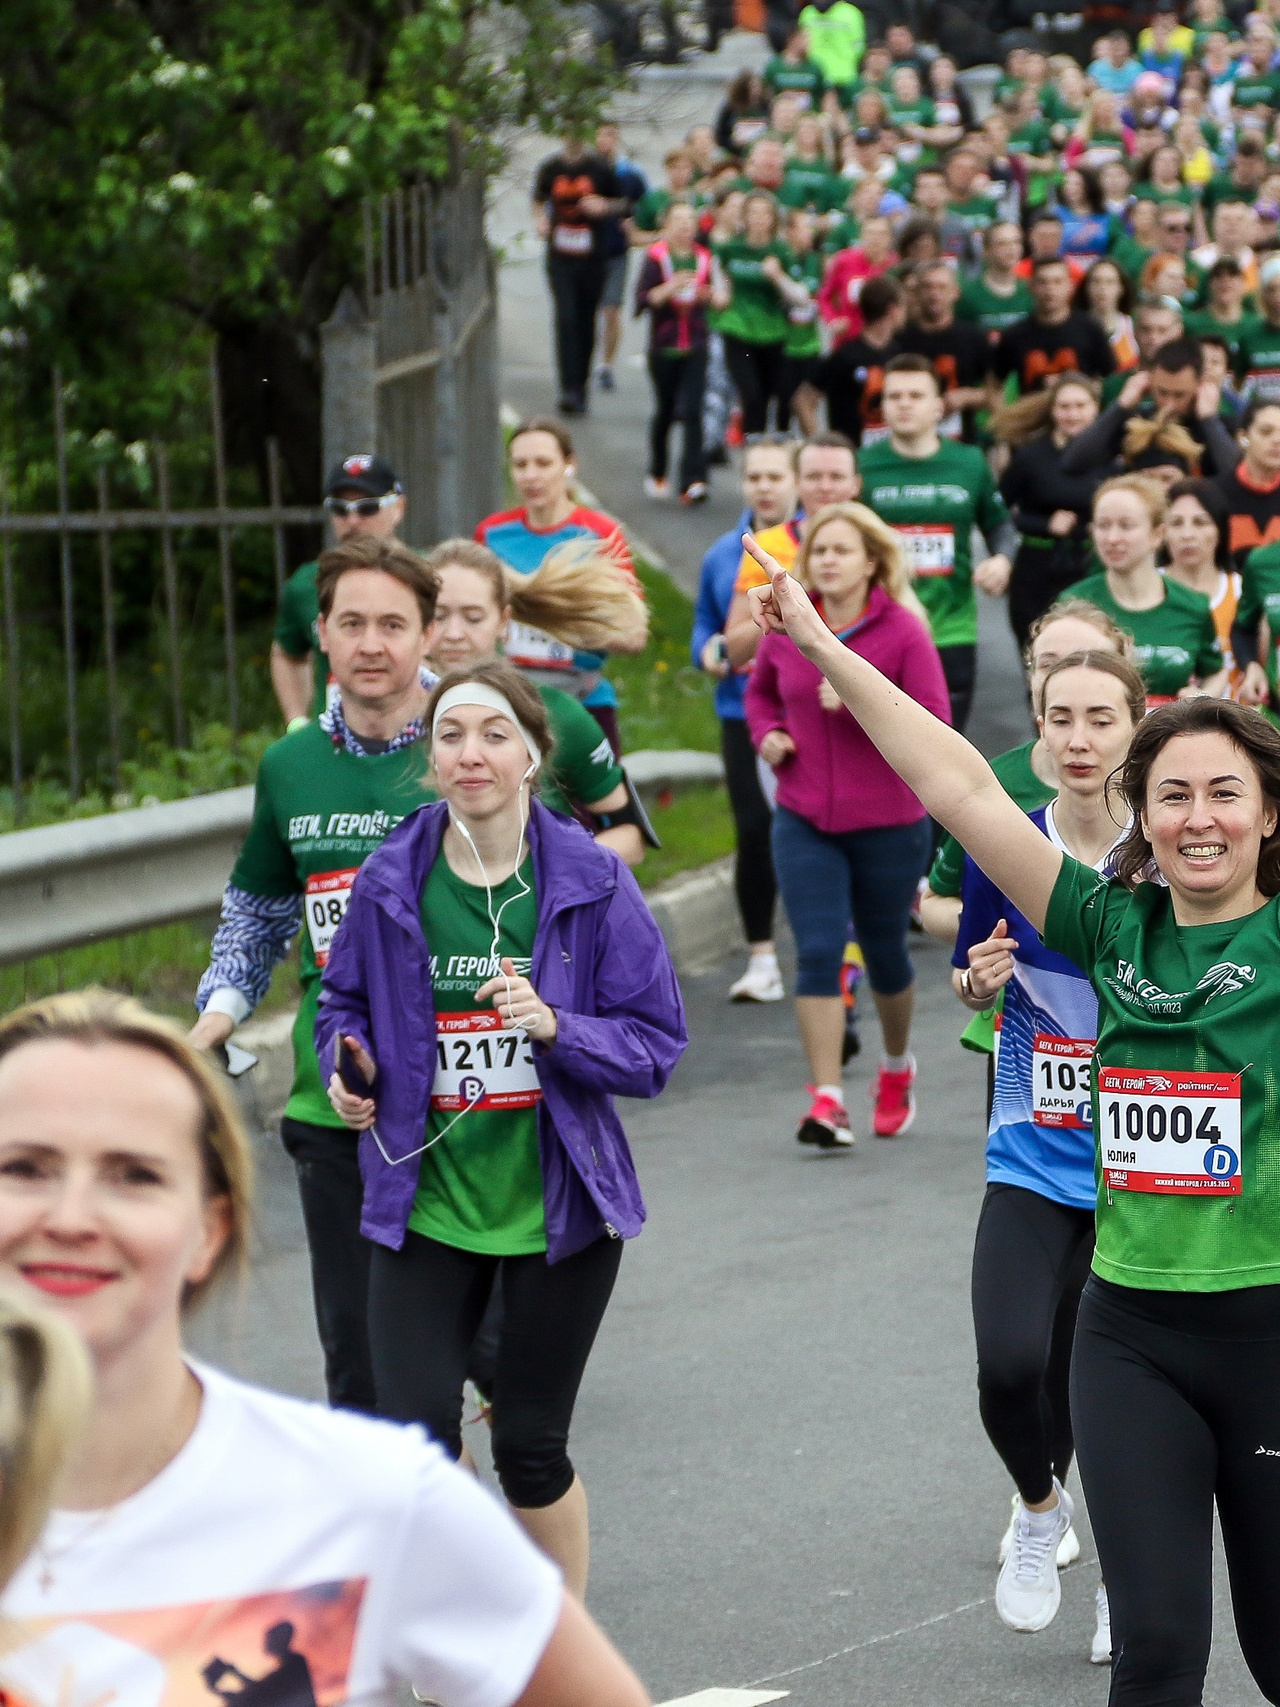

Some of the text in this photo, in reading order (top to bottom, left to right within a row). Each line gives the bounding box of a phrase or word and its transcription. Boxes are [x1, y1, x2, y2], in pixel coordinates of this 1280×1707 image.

[1162, 1001, 1182, 1014] 2023
[1041, 1060, 1091, 1092] 103
[1104, 1076, 1121, 1090] БЕГИ,
[1122, 1077, 1146, 1090] ГЕРОЙ!
[1039, 1096, 1075, 1108] ДАРЬЯ
[1108, 1101, 1222, 1145] 10004
[1107, 1149, 1137, 1164] ЮЛИЯ
[1211, 1149, 1232, 1175] D
